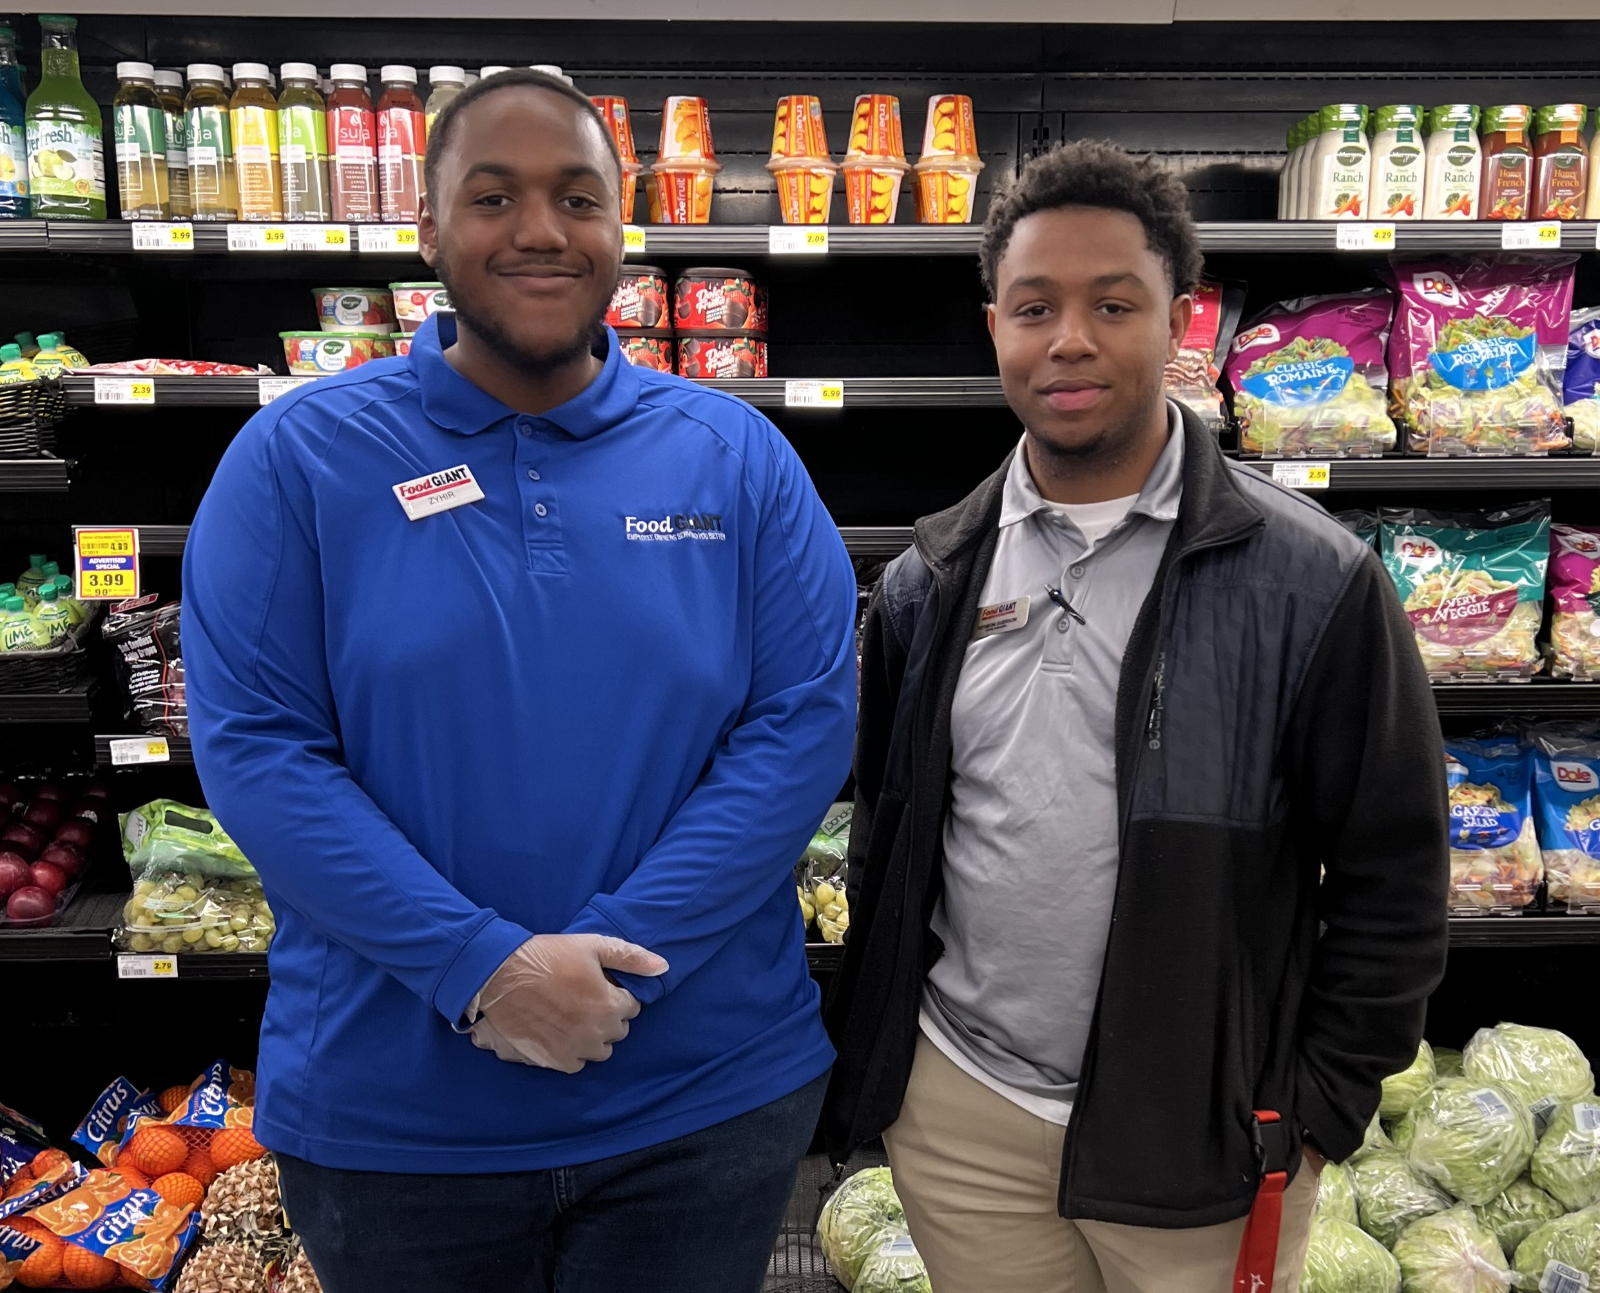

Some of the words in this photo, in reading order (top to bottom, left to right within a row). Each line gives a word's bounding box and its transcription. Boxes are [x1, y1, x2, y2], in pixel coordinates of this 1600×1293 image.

[340, 127, 370, 143] suja
[879, 104, 890, 150] truefruit
[1333, 172, 1364, 182] Ranch
[1386, 172, 1417, 182] Ranch
[1444, 172, 1474, 182] Ranch
[1498, 178, 1525, 186] French
[1552, 178, 1580, 186] French
[928, 177, 938, 222] ruefruit
[266, 232, 284, 240] 3.99
[1423, 278, 1452, 294] Dole
[1238, 326, 1272, 346] Dole
[1458, 336, 1507, 352] CLASSIC
[1452, 343, 1518, 366] ROMAINE
[1264, 363, 1335, 386] ROMAINE
[1274, 360, 1322, 374] CLASSIC
[399, 479, 432, 496] Food
[432, 468, 468, 486] GIANT
[428, 491, 456, 505] ZYHIR
[625, 516, 674, 532] Food
[674, 514, 722, 532] GIANT
[1402, 542, 1436, 556] Dole
[90, 574, 124, 586] 3.99
[1446, 594, 1477, 608] VERY
[1435, 601, 1490, 622] VEGGIE
[47, 617, 70, 638] IME
[5, 626, 33, 650] LIME
[1557, 766, 1591, 780] Dole
[1452, 804, 1500, 818] GARDEN
[1462, 816, 1498, 828] SALAD
[200, 1063, 224, 1116] Citrus
[88, 1083, 128, 1142] Citrus
[96, 1192, 148, 1244] Citrus
[0, 1225, 36, 1250] trus
